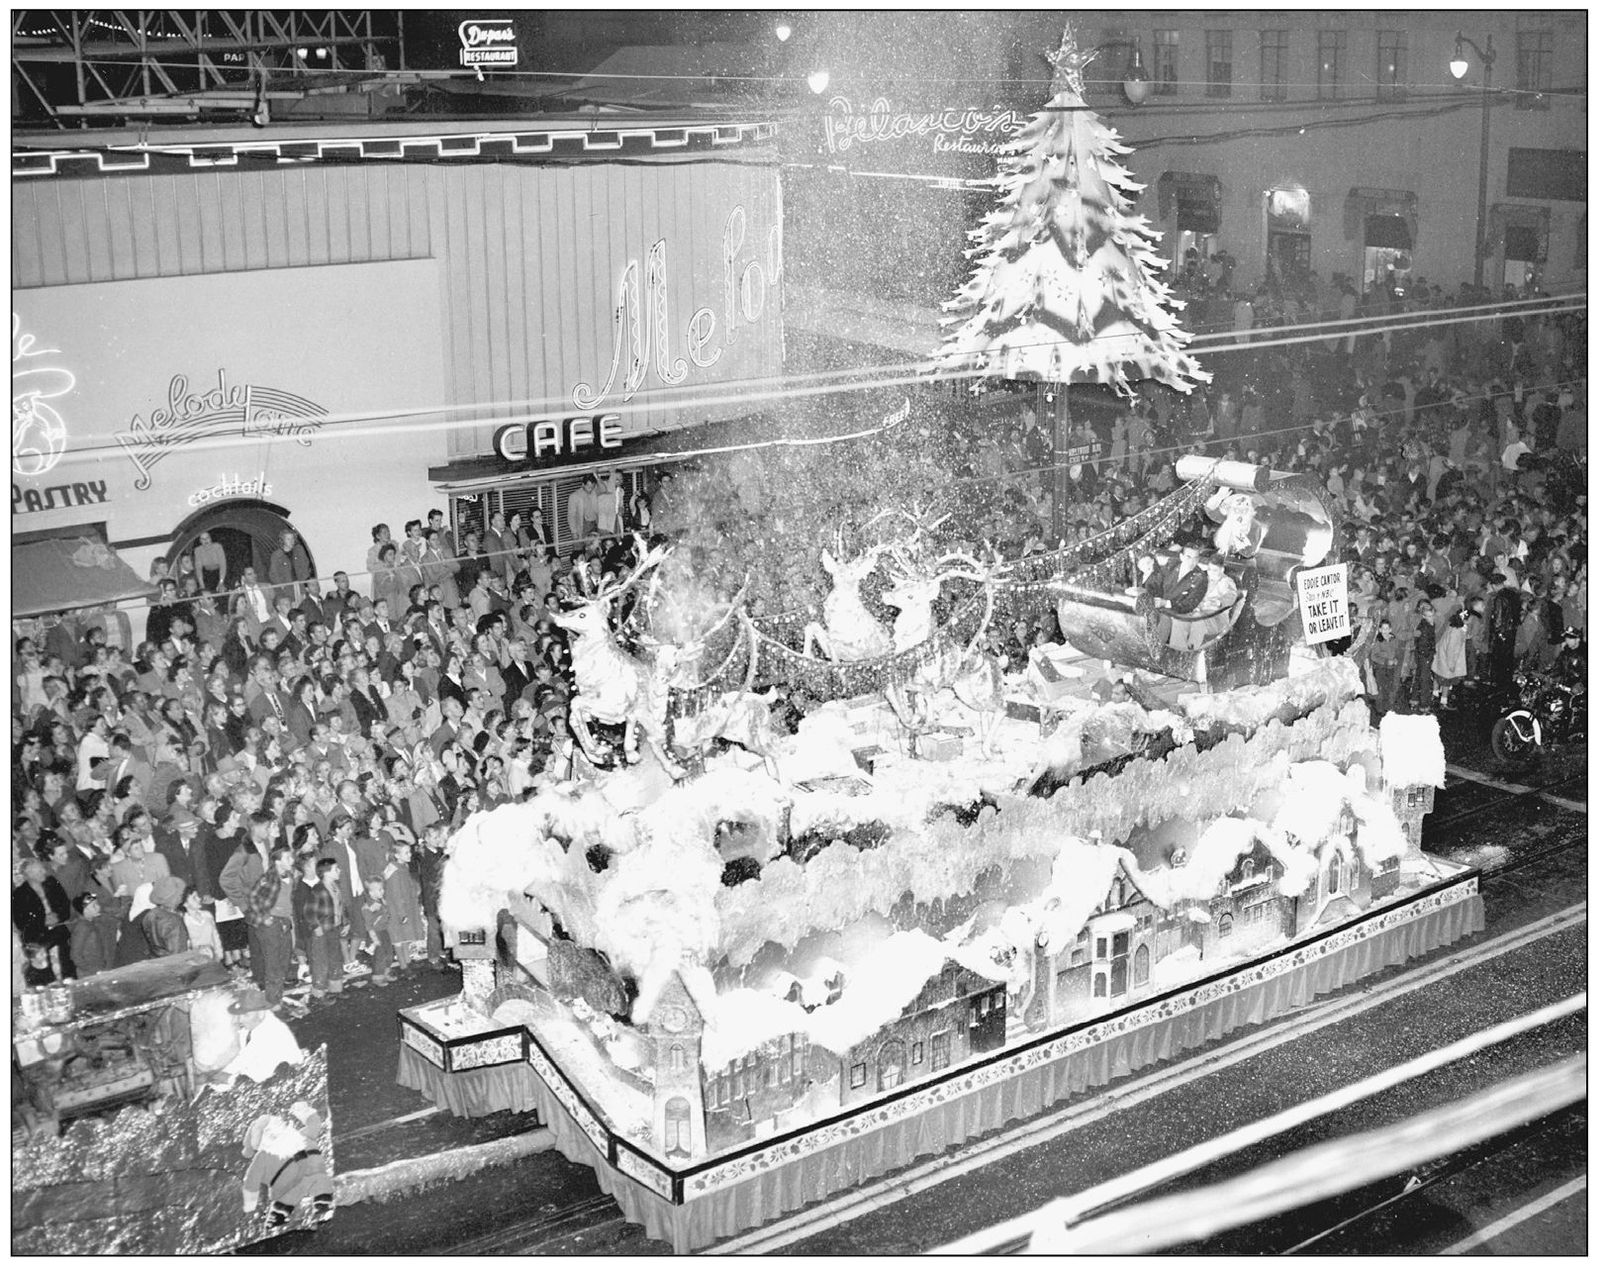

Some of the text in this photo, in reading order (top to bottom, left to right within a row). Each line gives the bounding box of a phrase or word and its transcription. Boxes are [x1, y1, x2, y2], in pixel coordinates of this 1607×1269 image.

[465, 51, 515, 62] RESTAURANT
[934, 134, 1010, 154] Restaura
[114, 367, 252, 490] Melody
[494, 414, 623, 461] CAFE
[13, 479, 107, 515] PASTRY
[188, 471, 273, 508] cocktails
[1304, 572, 1341, 590] EDDIE CANTOR
[1308, 600, 1339, 618] TAKE IT
[1309, 615, 1345, 634] OR LEAVE IT
